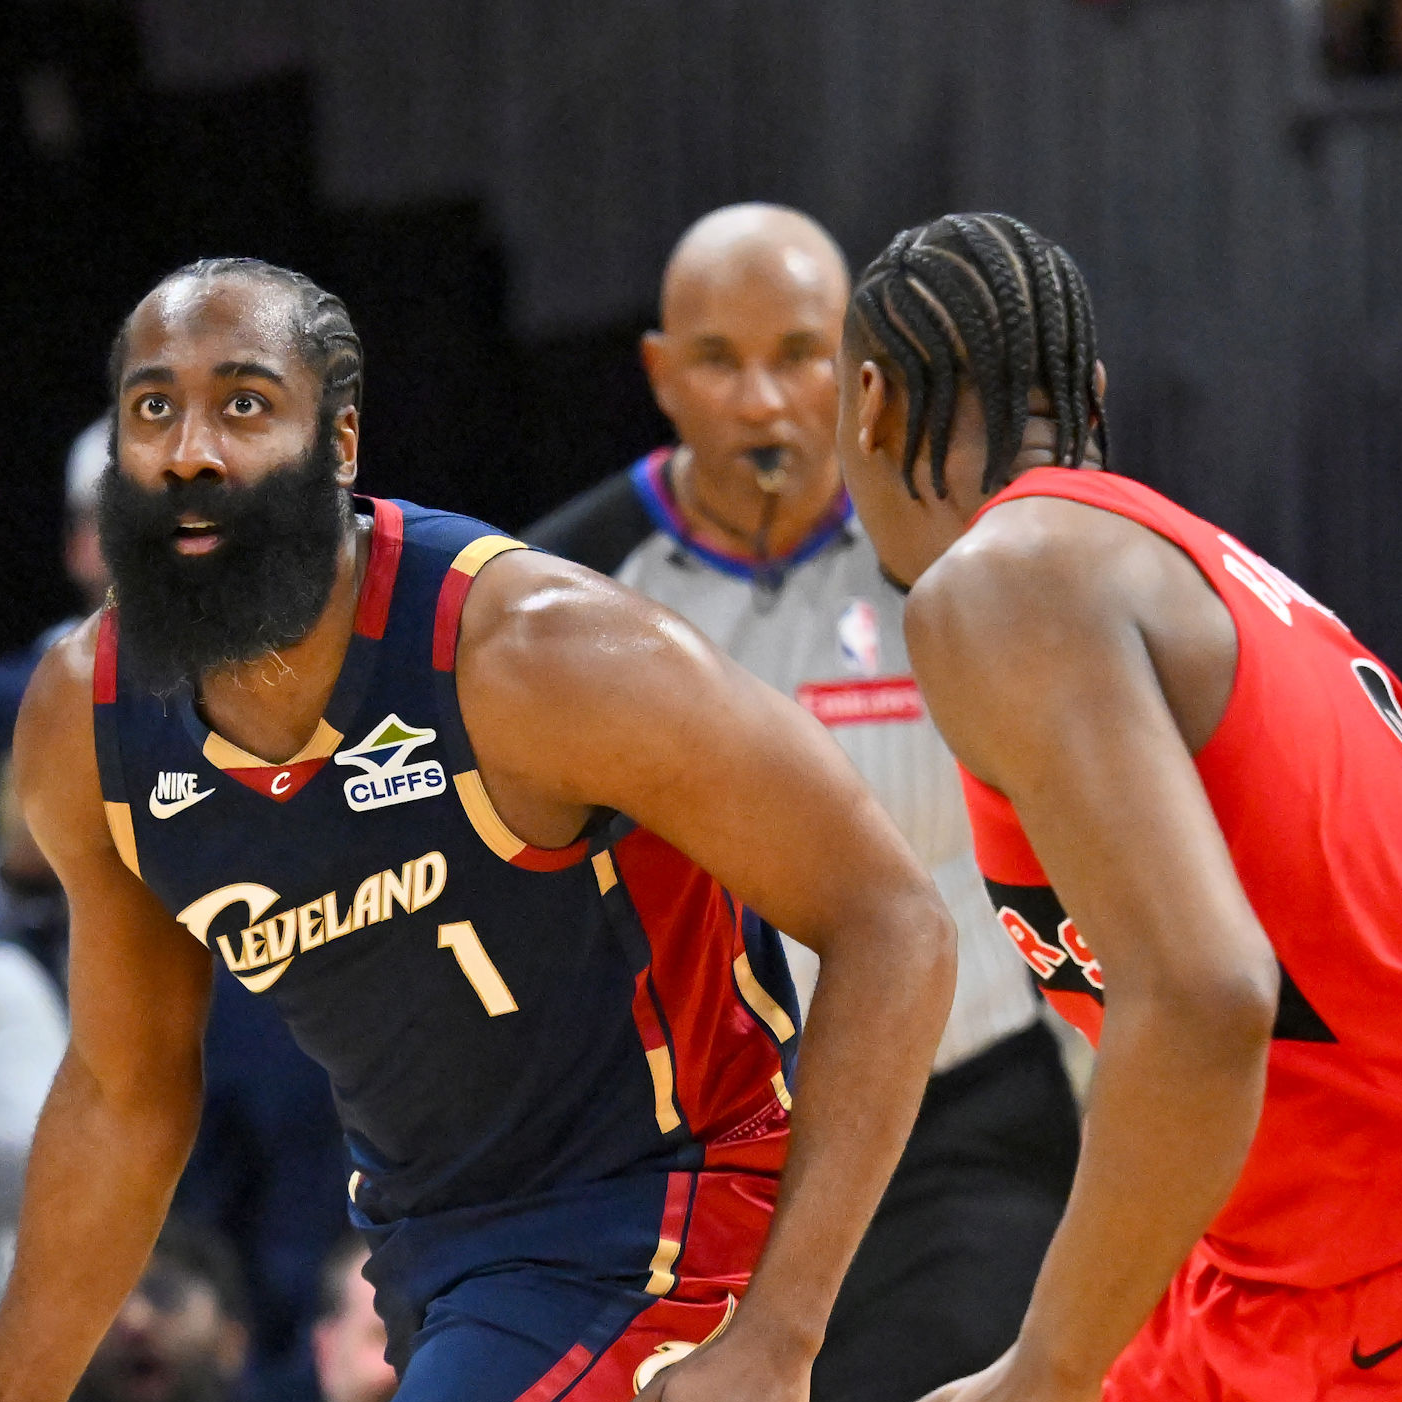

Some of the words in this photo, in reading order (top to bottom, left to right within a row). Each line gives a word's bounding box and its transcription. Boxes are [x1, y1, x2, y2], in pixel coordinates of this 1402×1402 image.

[157, 771, 200, 800] NIKE
[350, 767, 443, 804] CLIFFS
[176, 851, 448, 994] CLEVELAND
[437, 920, 520, 1018] 1
